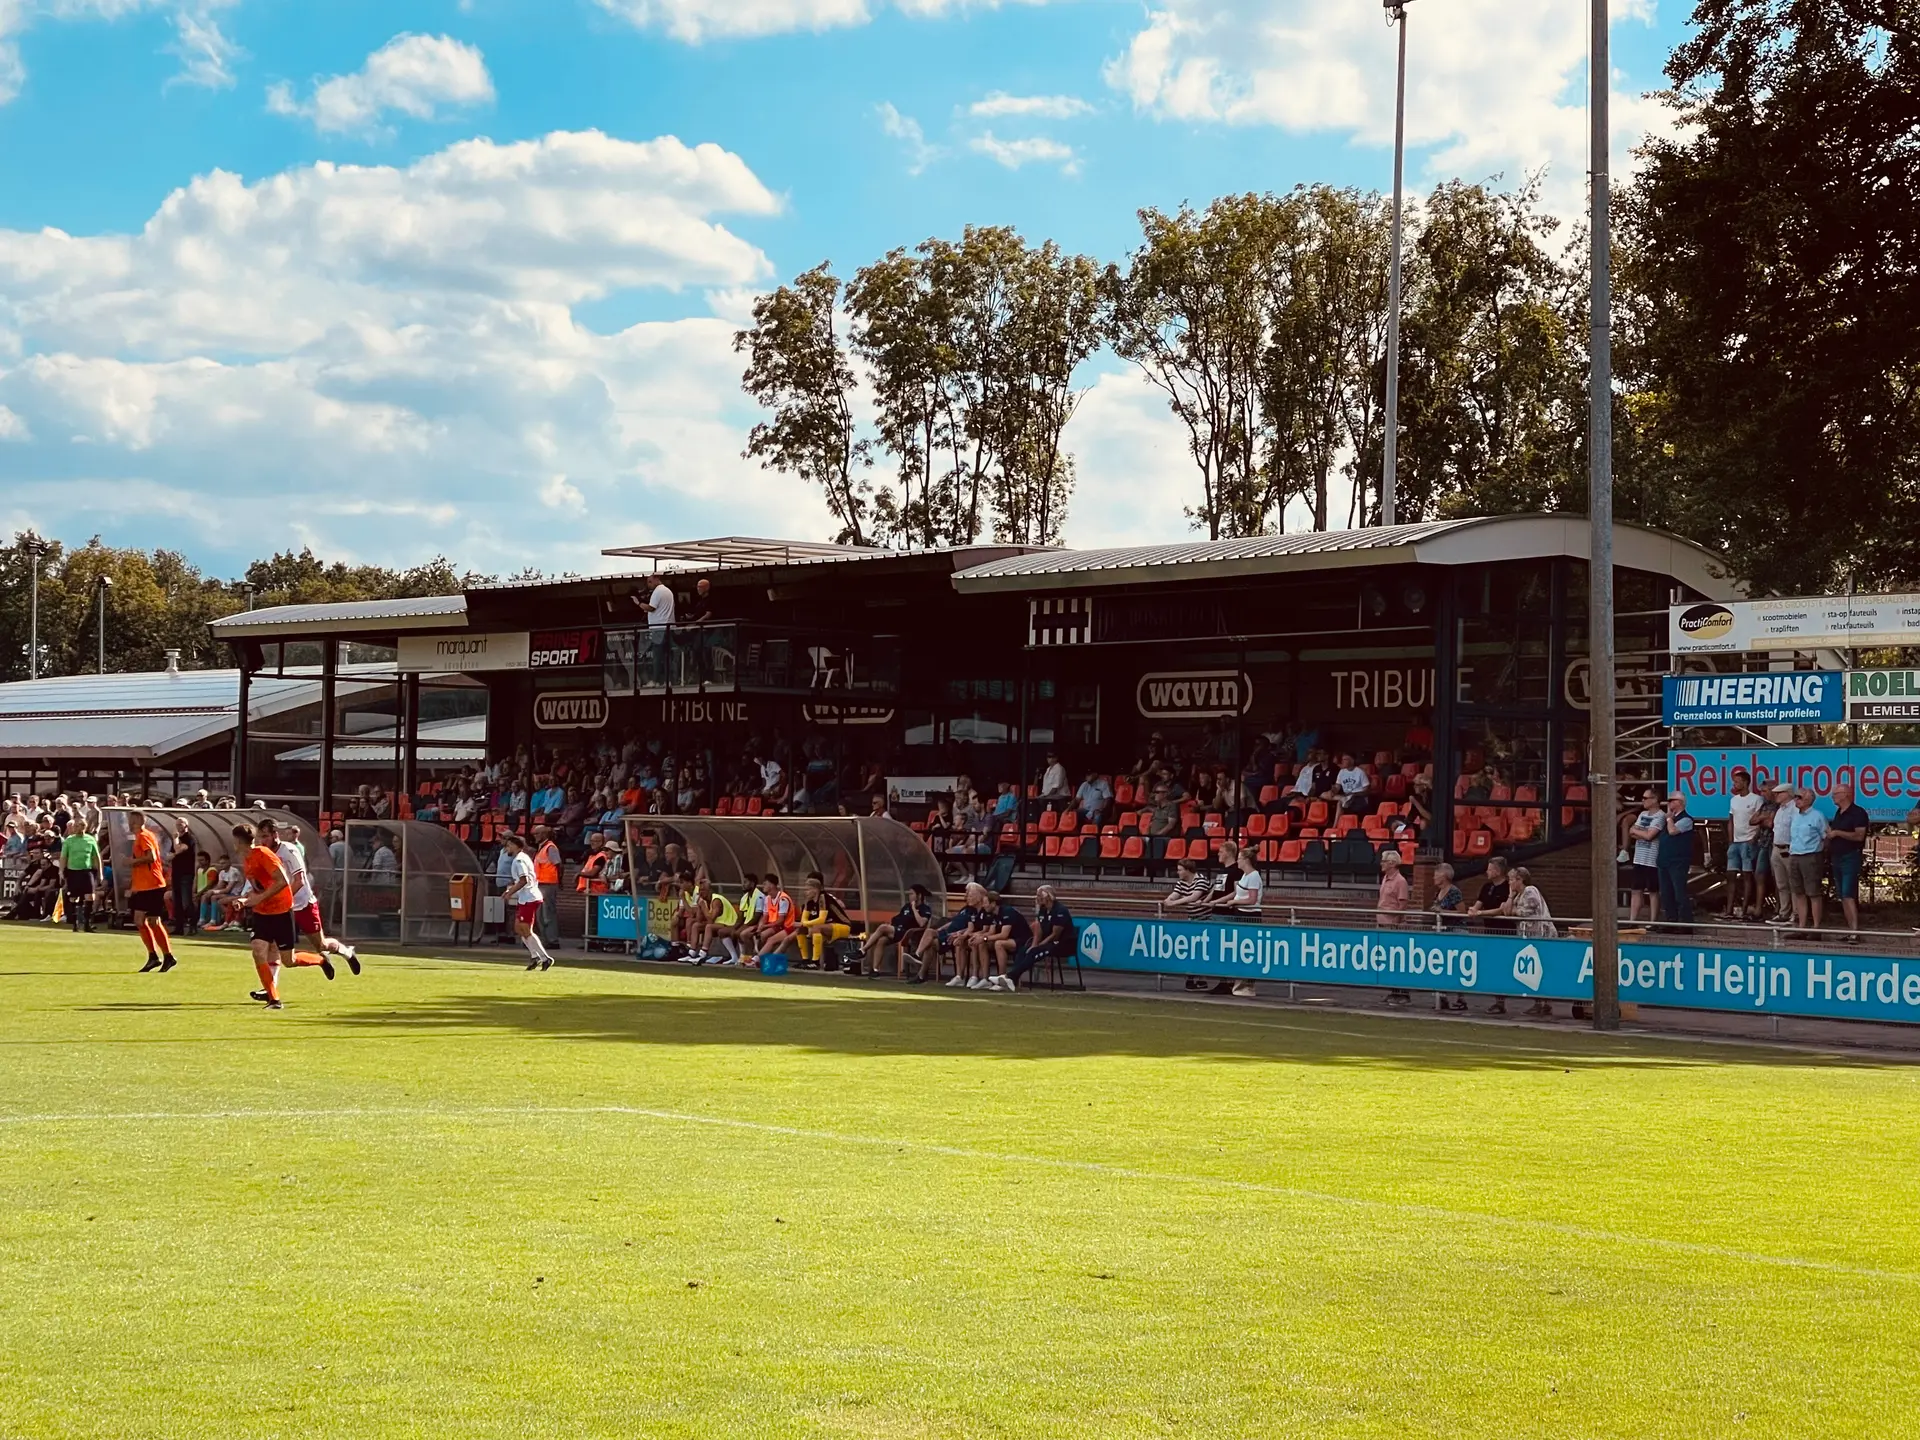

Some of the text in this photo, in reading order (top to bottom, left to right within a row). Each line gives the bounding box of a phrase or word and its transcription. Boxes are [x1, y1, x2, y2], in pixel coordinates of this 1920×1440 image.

[1680, 615, 1734, 629] PractiComfort
[1762, 612, 1808, 622] scootmobielen
[1827, 610, 1847, 619] sta-op
[1770, 624, 1800, 634] trapliften
[1830, 620, 1875, 631] relaxfauteuils
[530, 649, 579, 667] SPORT
[1700, 675, 1823, 706] HEERING
[1673, 708, 1821, 721] Grenzeloos in kunststof profielen
[1864, 705, 1920, 716] LEMELE
[603, 898, 643, 920] Sander
[1129, 924, 1479, 987] Albert Heijn Hardenberg
[1577, 946, 1920, 1006] Abert Heijn Harde
